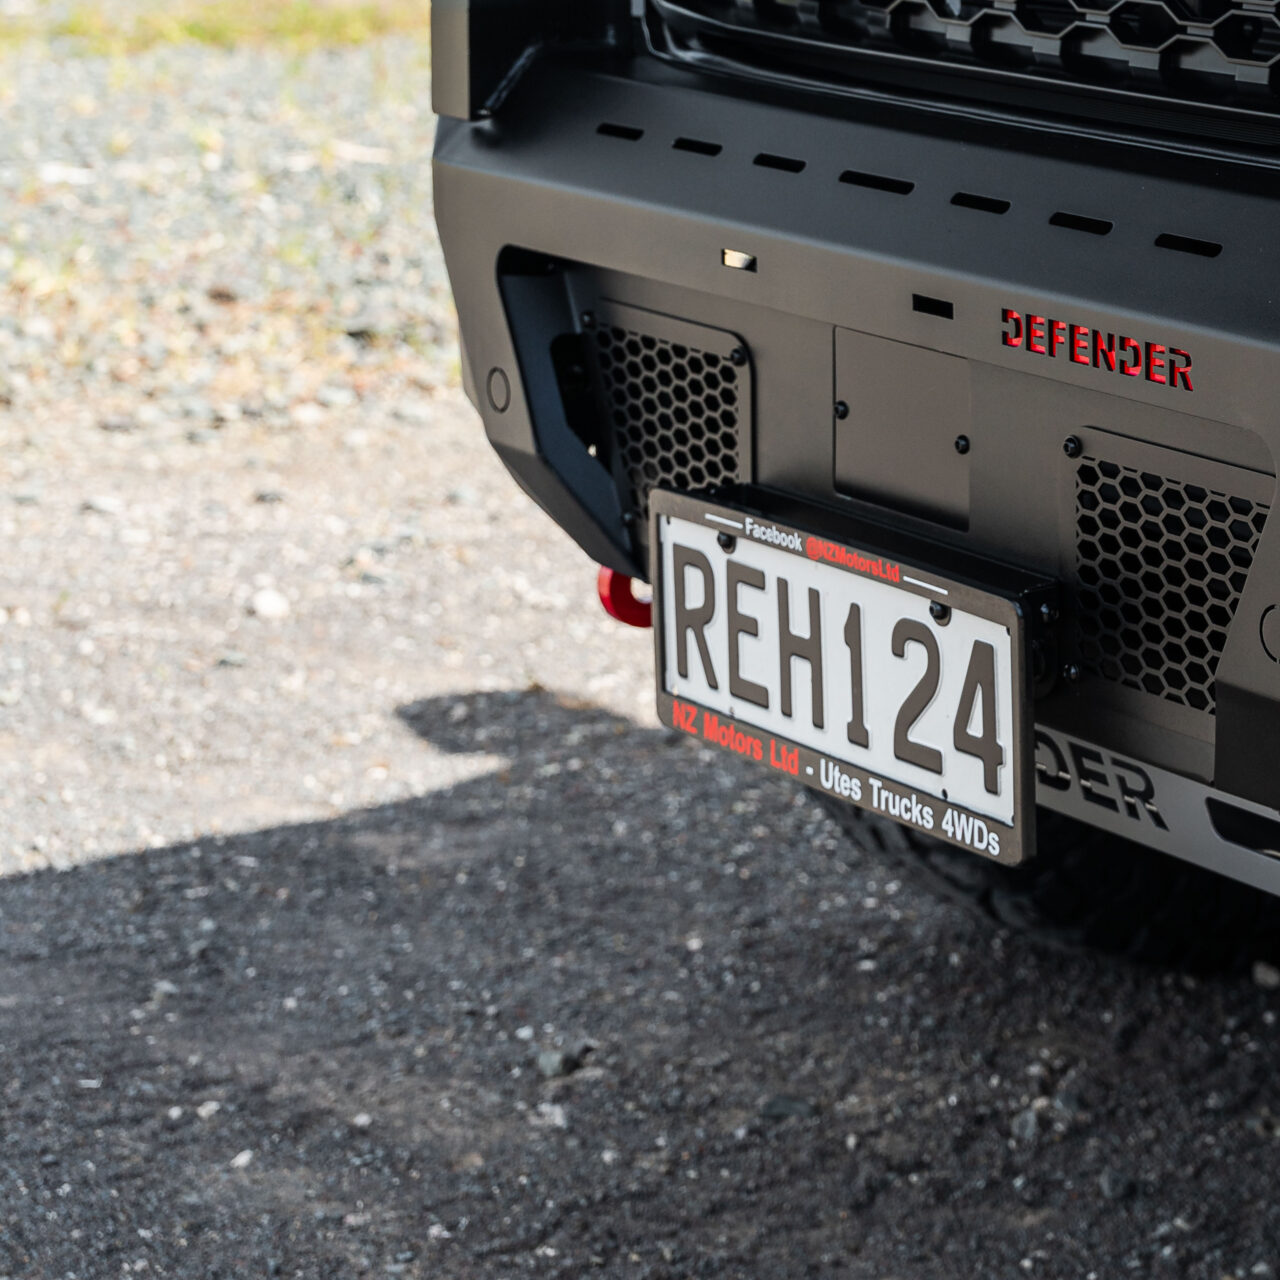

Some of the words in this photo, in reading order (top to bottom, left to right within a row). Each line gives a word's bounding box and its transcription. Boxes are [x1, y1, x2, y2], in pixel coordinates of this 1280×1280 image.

[1001, 307, 1194, 392] DEFENDER
[745, 517, 803, 552] Facebook
[806, 537, 900, 583] @NZMotorsLtd
[672, 542, 1005, 797] REH124
[672, 700, 698, 734] NZ
[703, 711, 763, 761] Motors
[770, 739, 800, 776] Ltd
[819, 758, 862, 802] Utes
[868, 778, 934, 830] Trucks
[941, 808, 1001, 857] 4WDs
